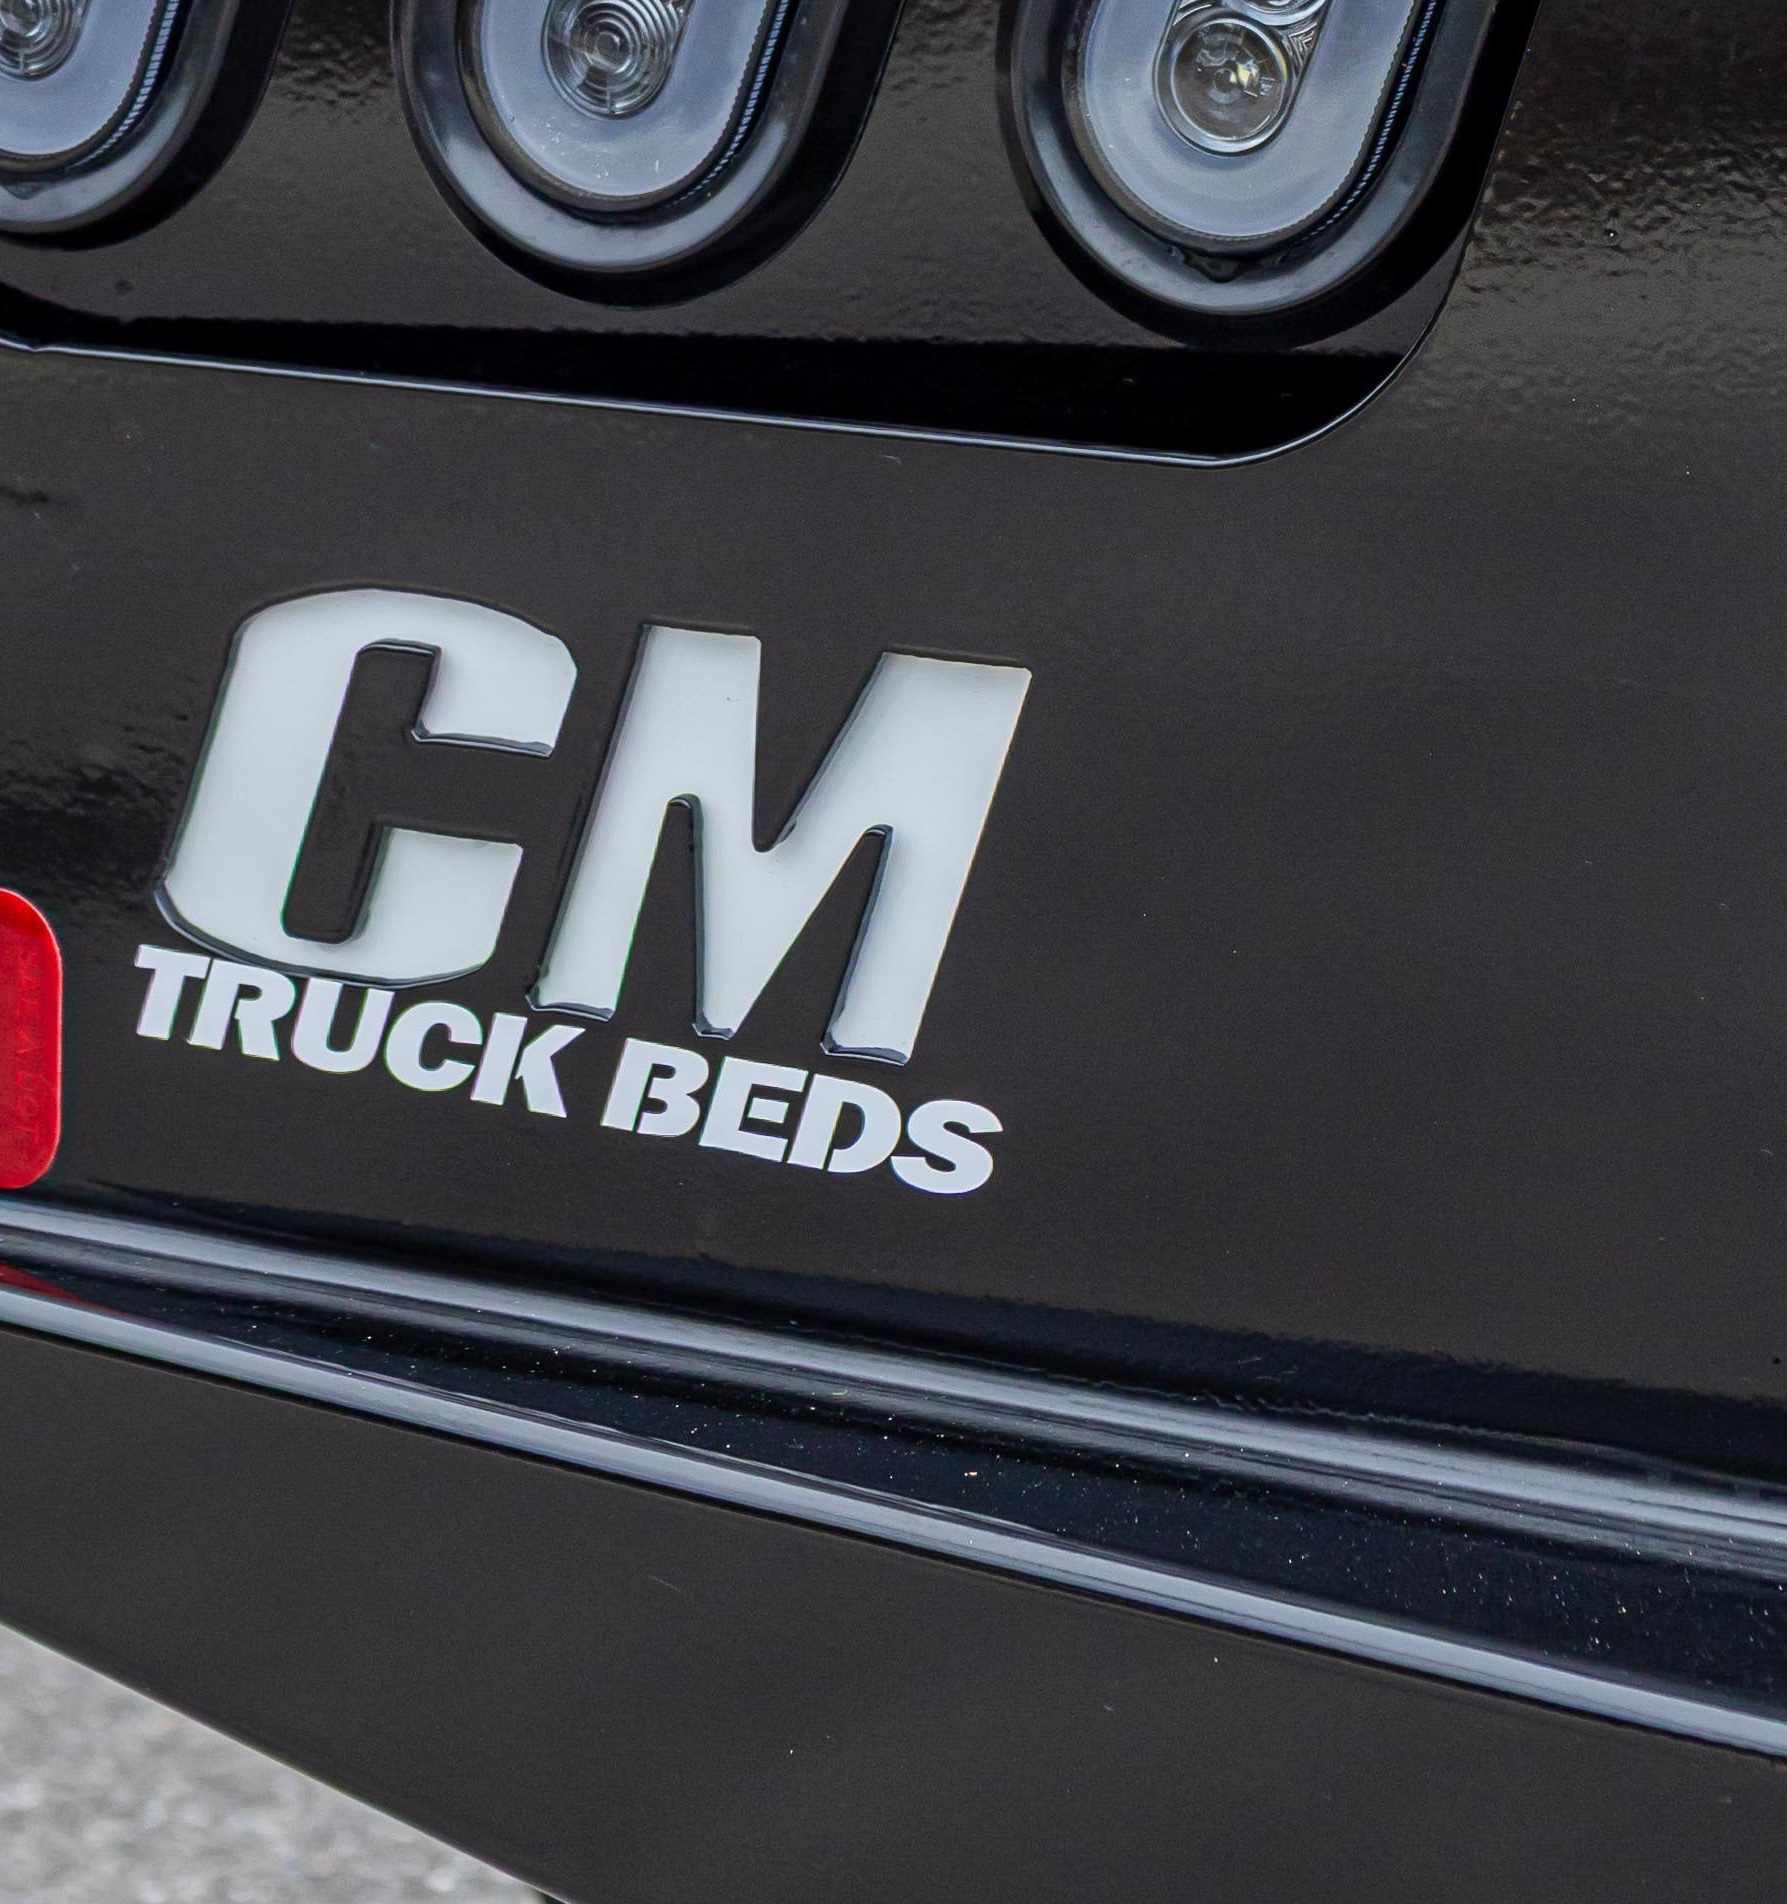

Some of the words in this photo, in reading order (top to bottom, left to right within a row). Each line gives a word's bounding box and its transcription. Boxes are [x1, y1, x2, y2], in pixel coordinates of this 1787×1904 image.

[154, 587, 1032, 1066] CM
[135, 944, 586, 1118] TRUCK
[601, 1037, 1003, 1194] BEDS
